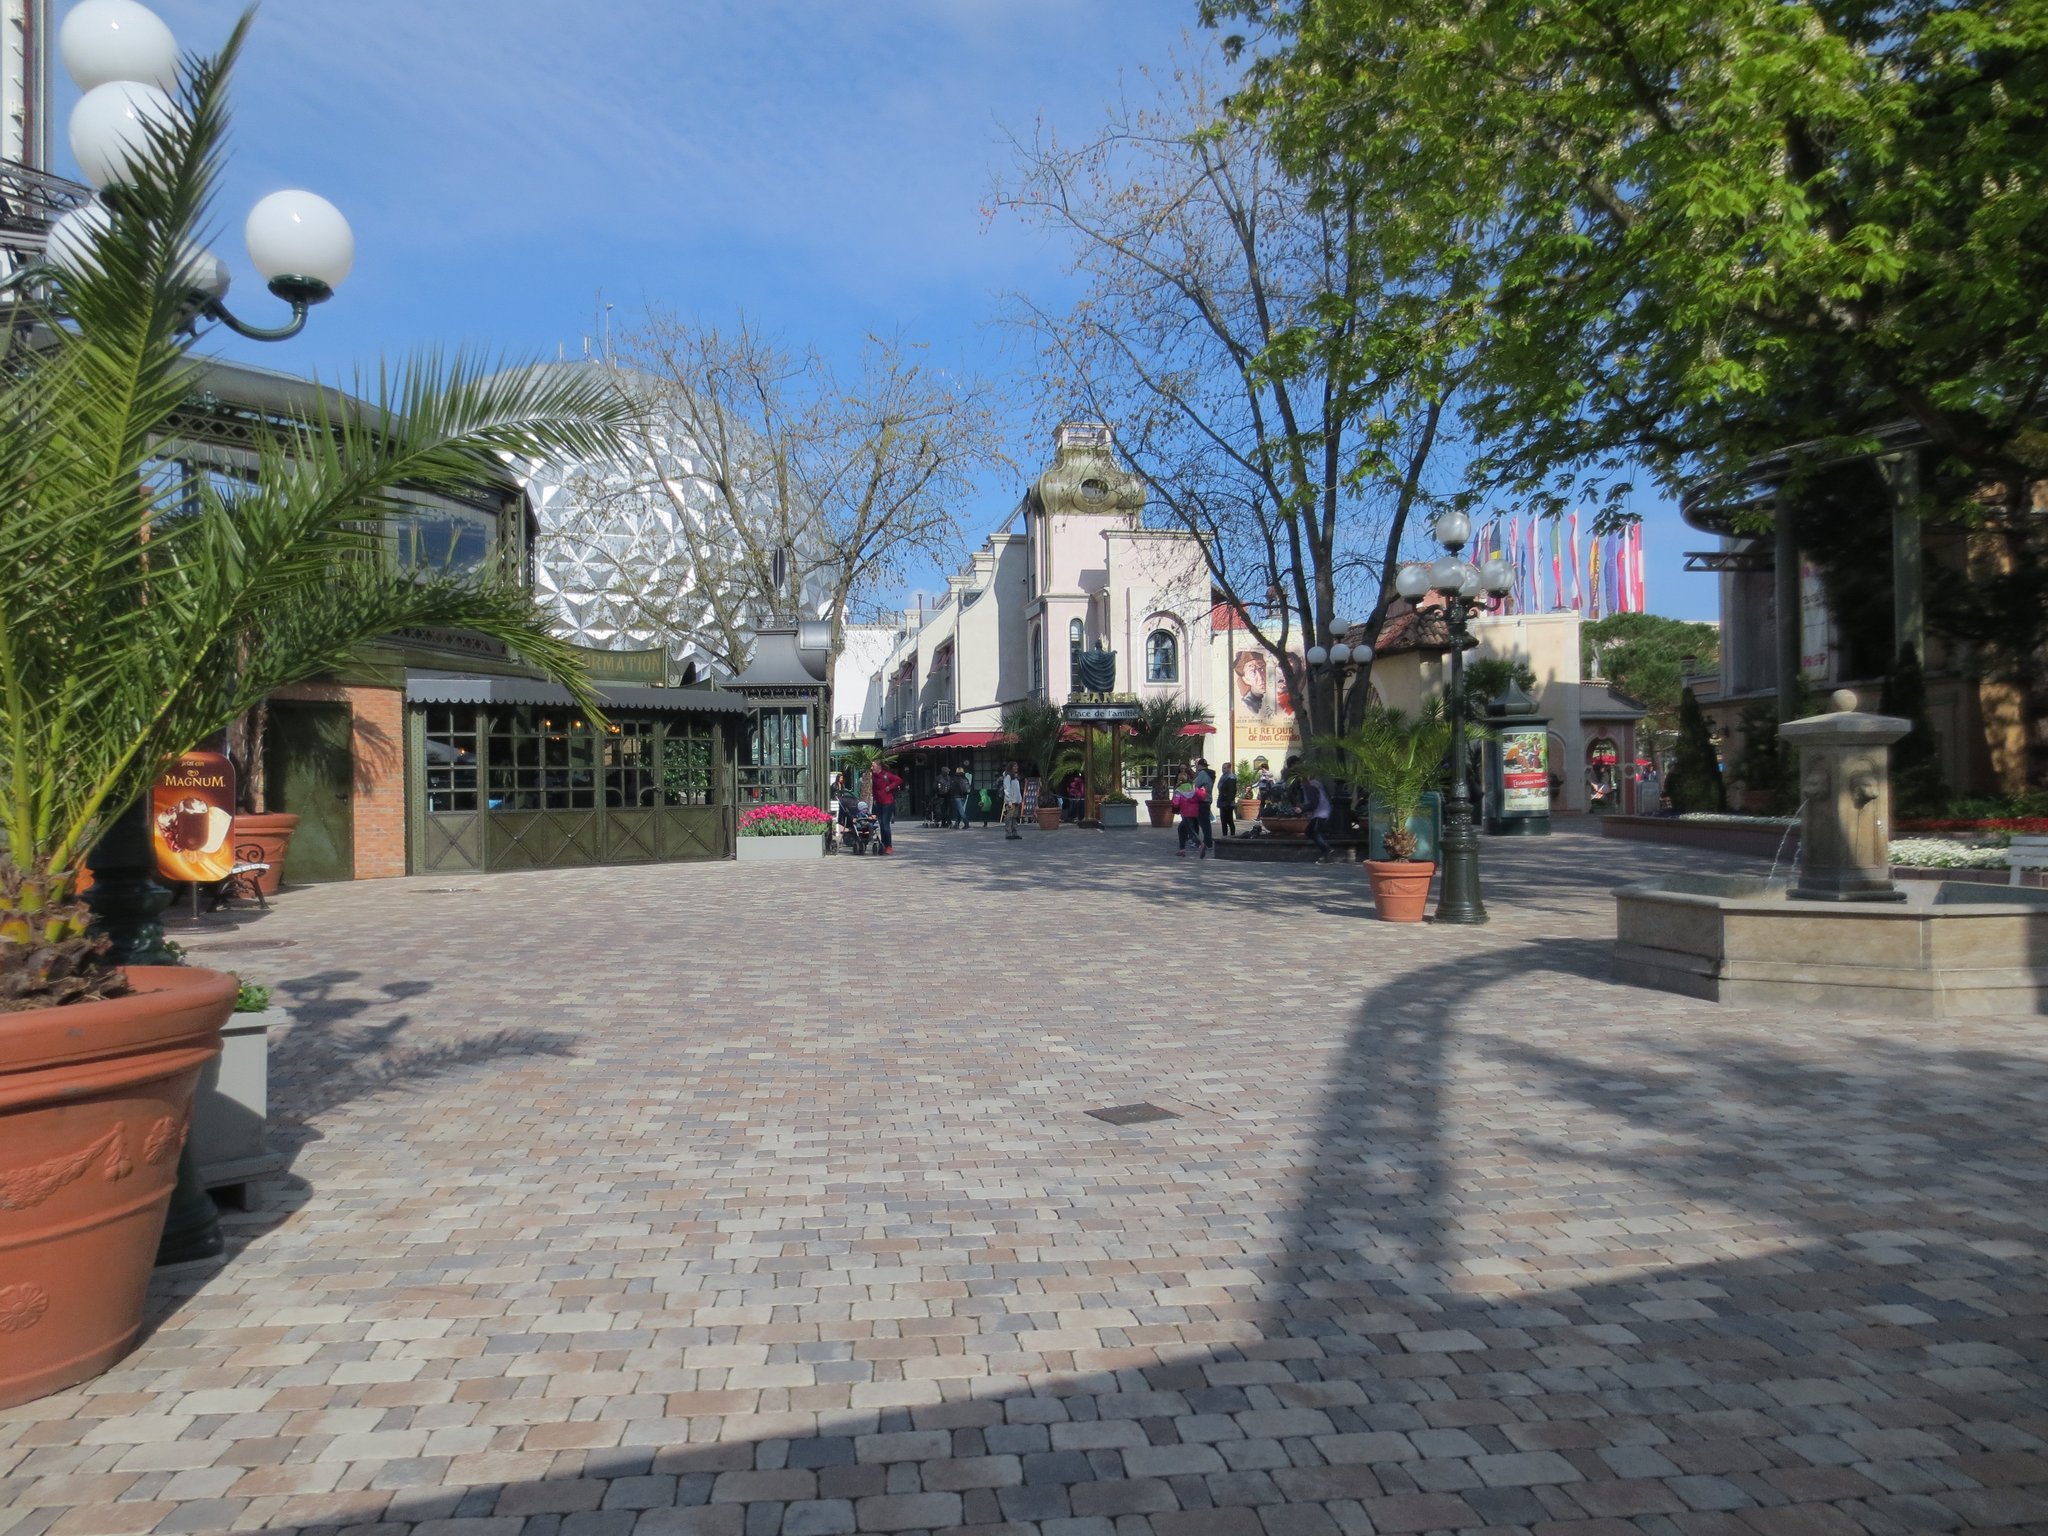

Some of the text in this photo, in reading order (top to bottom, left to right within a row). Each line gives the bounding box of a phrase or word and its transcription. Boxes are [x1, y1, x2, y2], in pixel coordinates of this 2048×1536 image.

[582, 653, 661, 673] ORMATION
[1094, 709, 1105, 717] de
[1248, 727, 1294, 735] LE RETOUR
[1248, 734, 1257, 742] de
[1258, 734, 1272, 742] Don
[165, 775, 224, 787] MAGNUM
